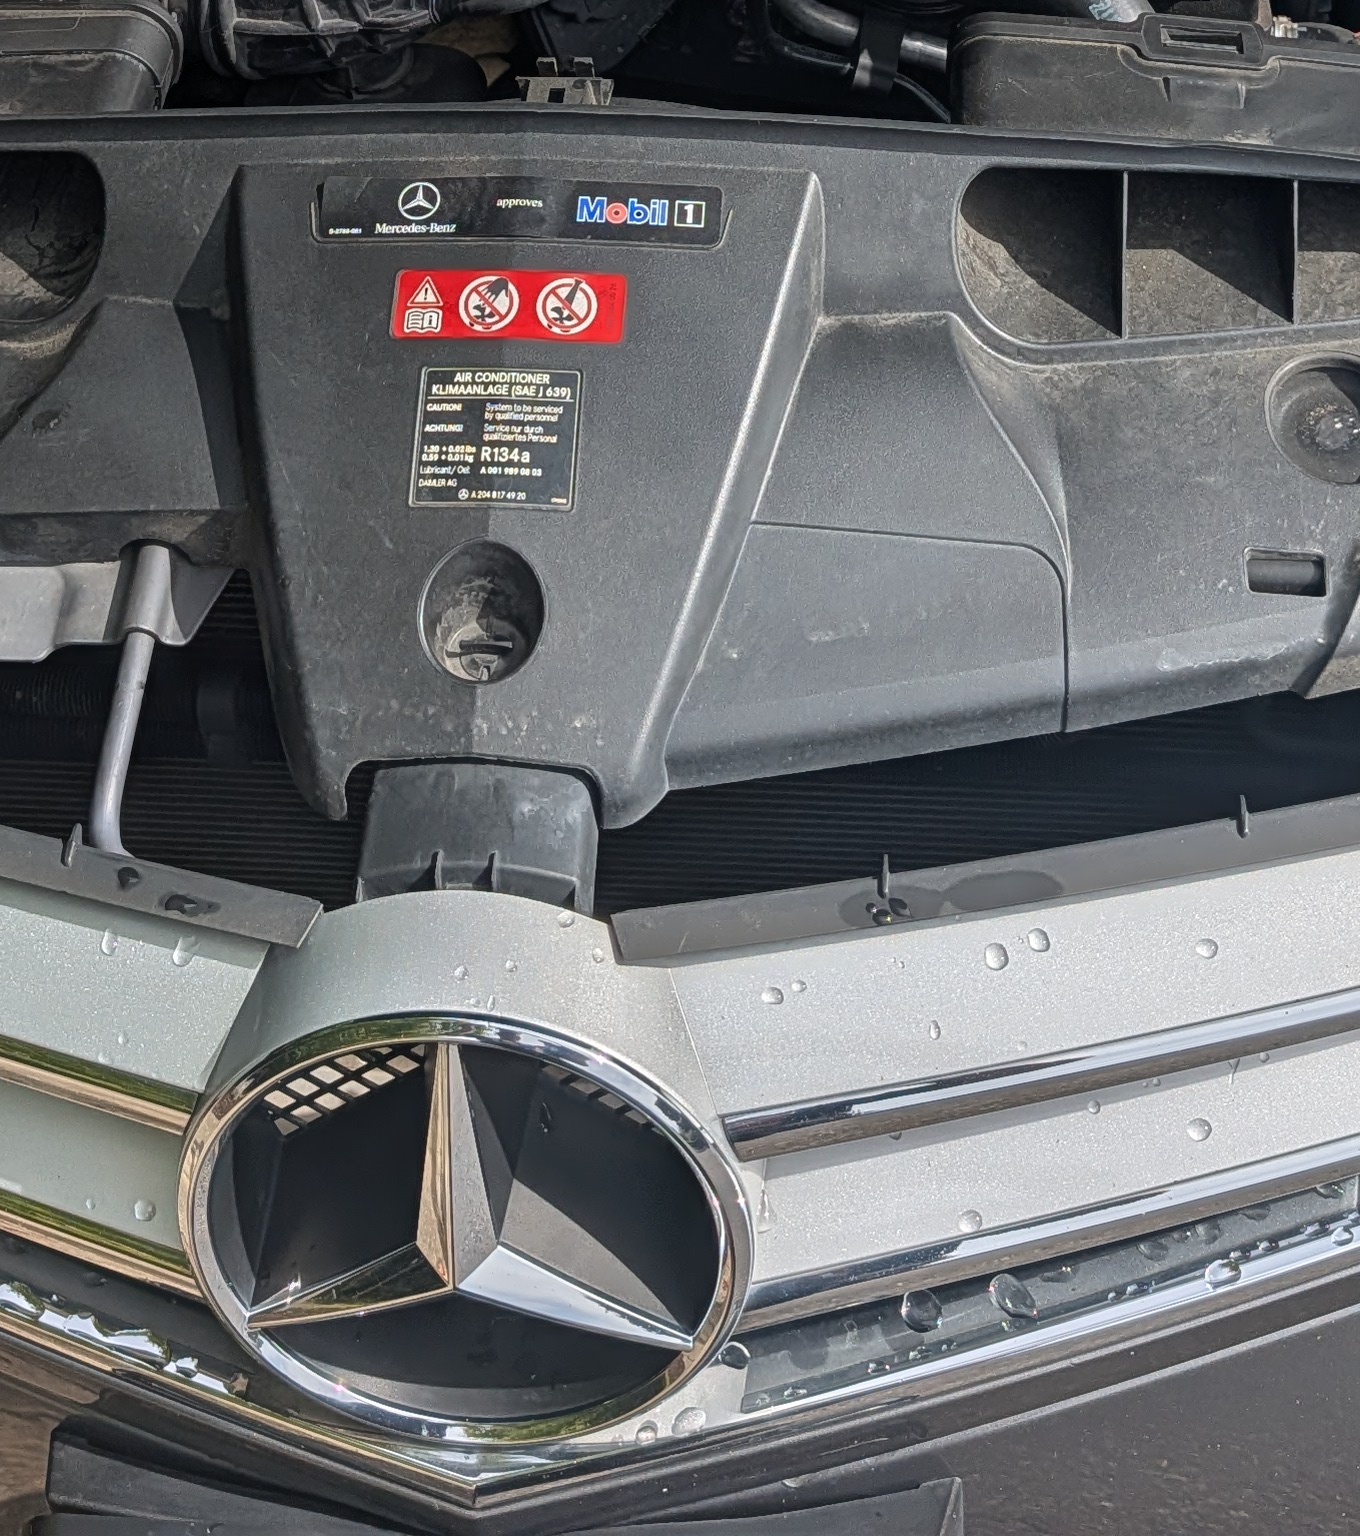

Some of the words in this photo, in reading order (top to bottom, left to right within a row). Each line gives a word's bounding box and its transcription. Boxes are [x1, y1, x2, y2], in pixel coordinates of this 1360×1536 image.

[496, 196, 543, 209] approves
[576, 195, 669, 226] Mobil
[374, 223, 456, 234] Mercedes-Benz
[454, 372, 472, 383] AIR
[474, 372, 550, 384] CONDITIONER
[431, 384, 509, 395] KLIMAANLAGE
[511, 385, 536, 398] (SAE
[546, 387, 572, 400] 639)
[426, 403, 462, 411] CAUTION!
[485, 402, 512, 412] System
[513, 403, 521, 412] to
[522, 404, 532, 412] be
[533, 405, 563, 414] serviced
[484, 412, 494, 421] by
[495, 412, 523, 421] qualified
[524, 413, 558, 422] personnel
[484, 424, 510, 433] Service
[511, 425, 522, 433] nur
[524, 425, 544, 434] durch
[527, 434, 557, 443] Personal
[464, 454, 474, 463] kg
[480, 446, 530, 463] R134a
[480, 466, 486, 474] A
[487, 466, 502, 474] 001
[447, 479, 458, 487] AG
[470, 491, 476, 499] A
[477, 491, 491, 499] 204
[492, 491, 505, 499] 817
[516, 492, 526, 500] 20
